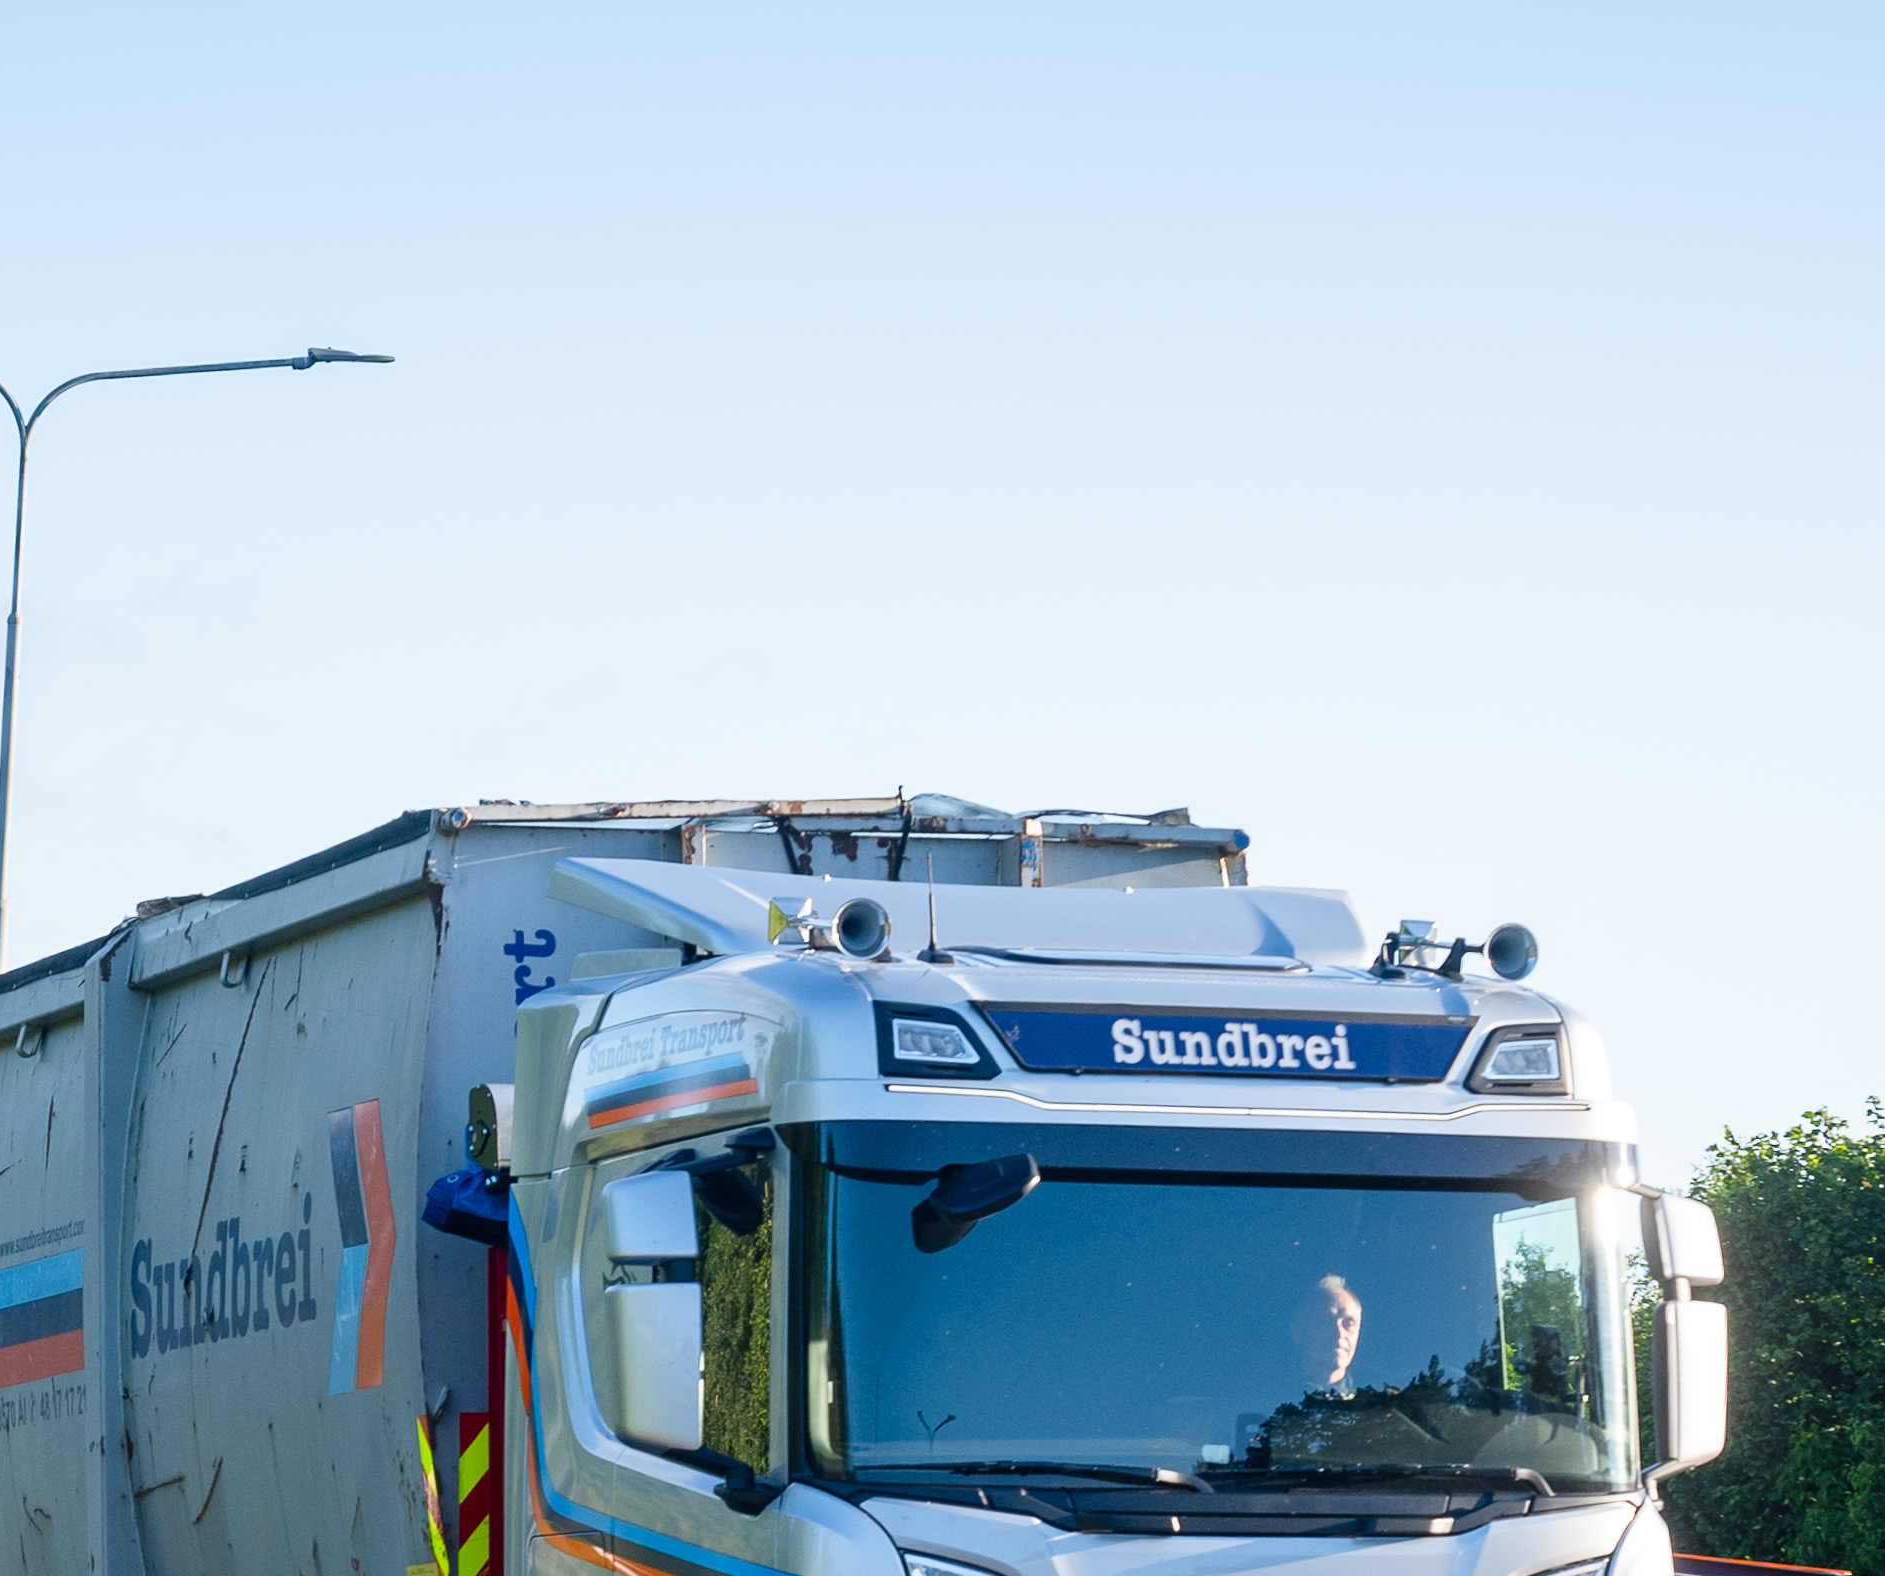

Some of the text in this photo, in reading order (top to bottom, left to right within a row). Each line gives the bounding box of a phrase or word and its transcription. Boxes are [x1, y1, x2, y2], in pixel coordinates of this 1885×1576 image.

[587, 1014, 747, 1076] Sundbrei Transport
[1111, 1018, 1357, 1071] Sundbrei
[130, 1192, 317, 1359] Sundbrei
